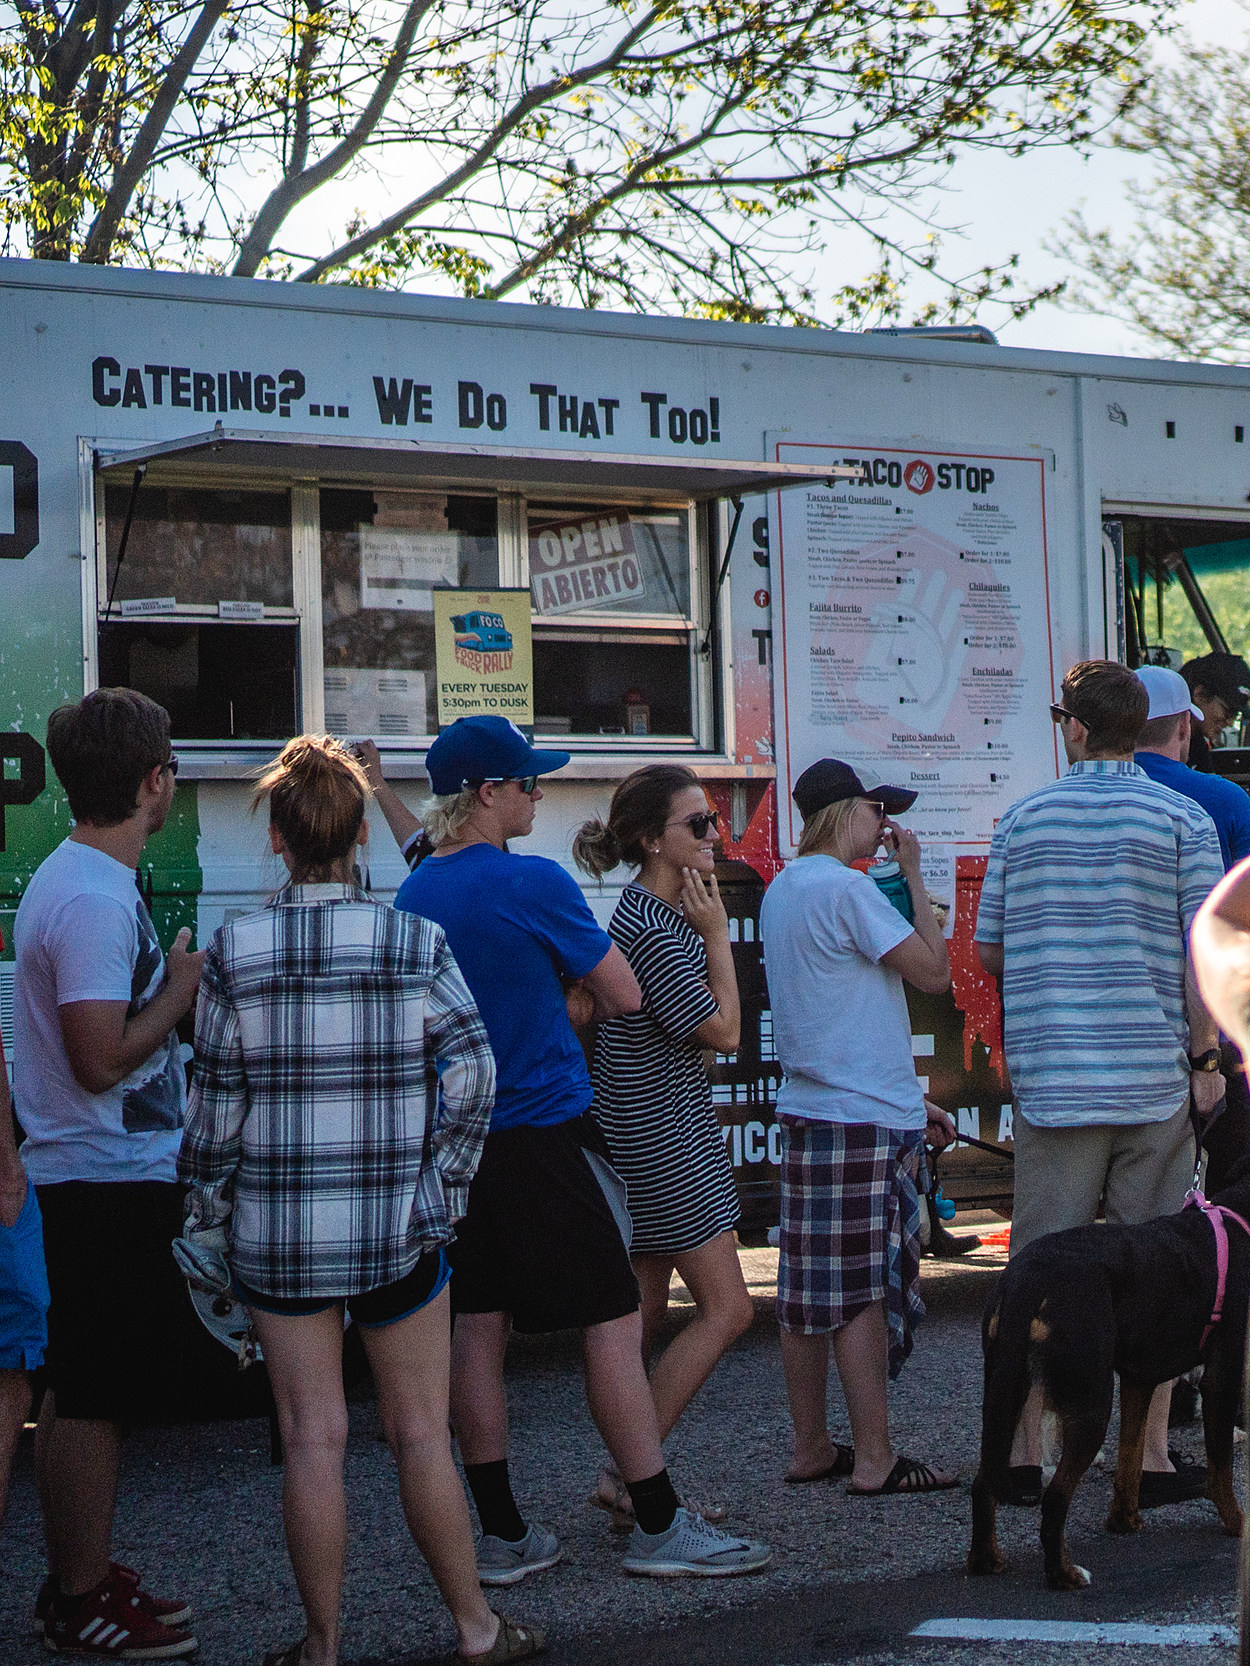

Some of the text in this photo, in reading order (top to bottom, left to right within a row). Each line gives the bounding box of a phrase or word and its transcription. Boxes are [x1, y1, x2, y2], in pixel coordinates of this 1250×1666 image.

[373, 376, 433, 425] WE
[459, 381, 507, 431] DO
[530, 384, 620, 439] THAT
[641, 392, 721, 445] TOO!
[843, 458, 995, 494] TACO STOP
[806, 493, 829, 501] Tacos
[848, 495, 892, 505] Quesadillas
[972, 502, 999, 512] Nachos
[538, 517, 624, 567] OPEN
[541, 558, 639, 610] ABIERTO
[968, 582, 1010, 592] Chilaquiles
[809, 603, 862, 613] Fajita Burrito
[480, 616, 504, 628] FO CO
[455, 647, 482, 663] FOOD
[810, 646, 835, 656] Salads
[455, 656, 482, 675] TRUCK
[483, 652, 514, 675] RALLY
[972, 667, 1013, 676] Enchiladas
[442, 683, 529, 693] EVERY TUESDAY
[443, 698, 529, 708] 5:30pm TO DUSK
[892, 733, 955, 742] Pepito Sandwich
[910, 772, 940, 781] Dessert
